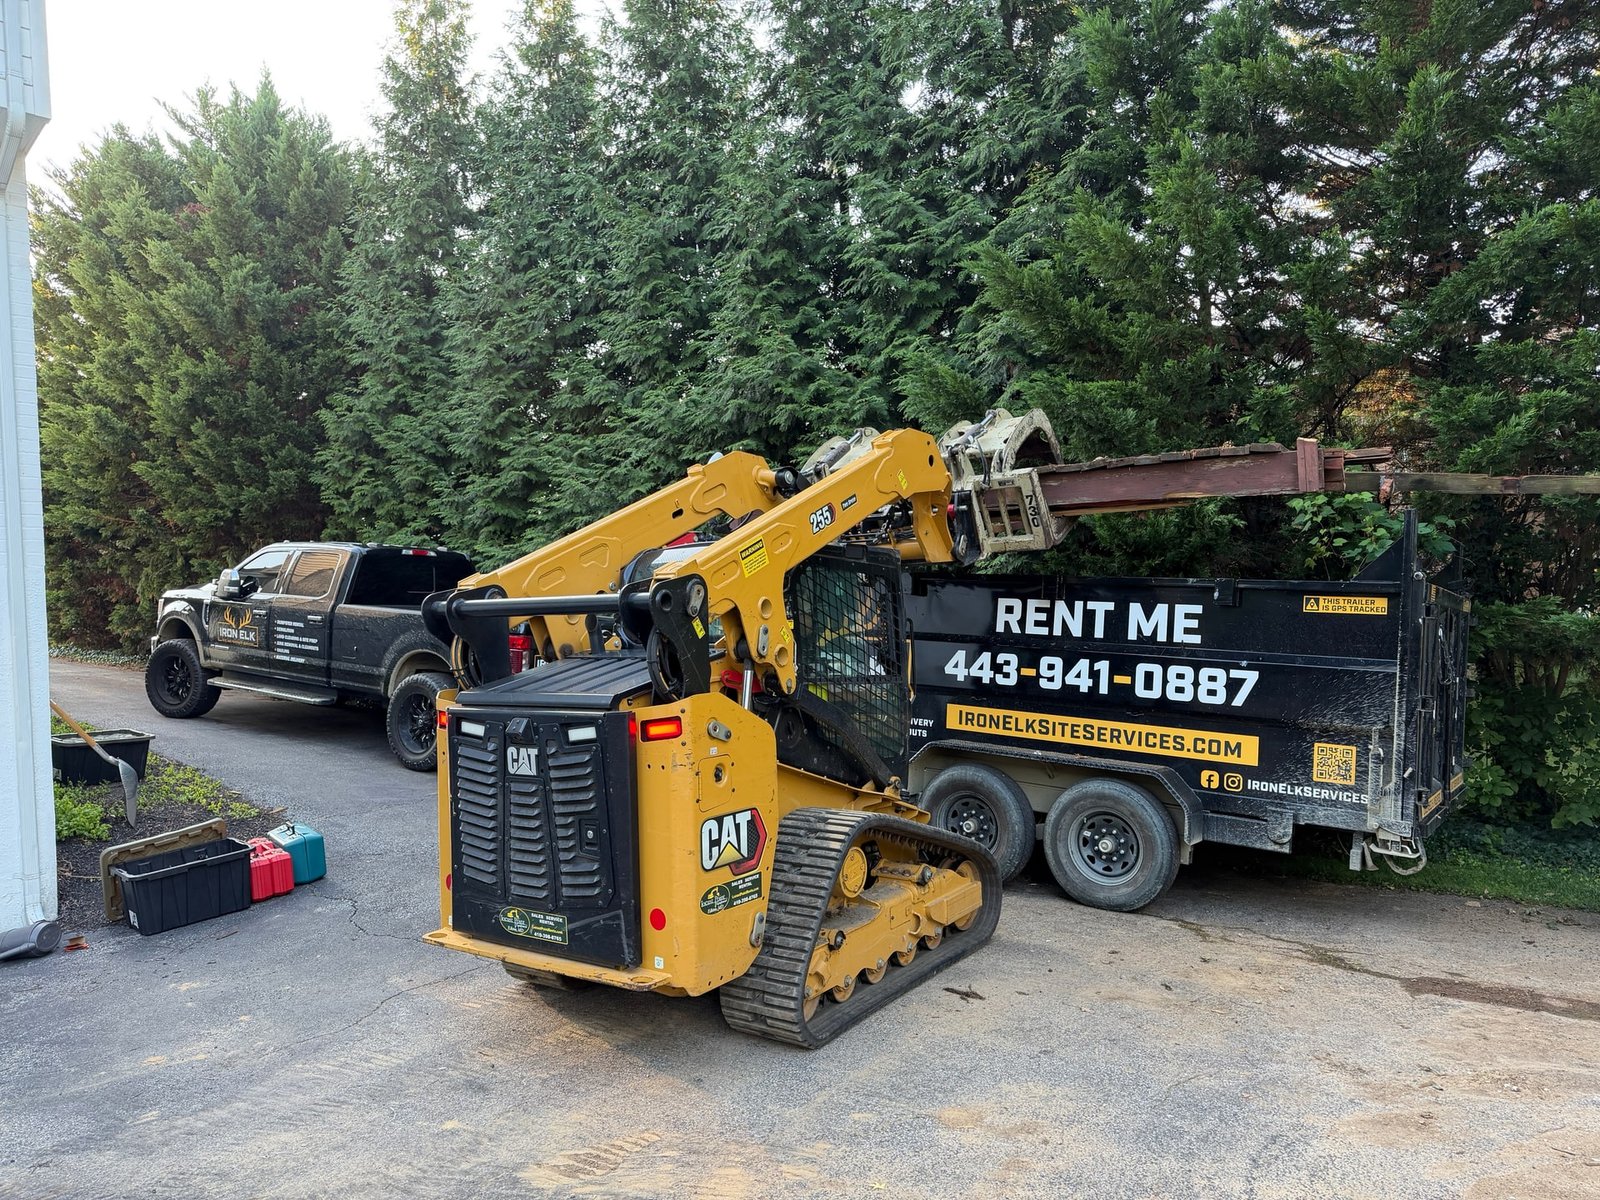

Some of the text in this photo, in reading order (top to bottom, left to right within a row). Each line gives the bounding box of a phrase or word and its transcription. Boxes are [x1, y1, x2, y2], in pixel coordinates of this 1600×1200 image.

[810, 505, 831, 534] 255
[1025, 494, 1040, 528] 730
[1343, 598, 1375, 606] TRAILER
[1349, 605, 1386, 613] TRACKED
[219, 627, 256, 641] IRON ELK
[995, 597, 1204, 644] RENT ME
[944, 650, 1260, 707] 443-941-0887
[911, 717, 934, 727] IVERY
[958, 709, 1243, 759] IRONELKSITESERVICES.COM
[507, 746, 539, 776] CAT
[1248, 779, 1369, 804] IRONELKSERVICES
[702, 811, 751, 870] CAT
